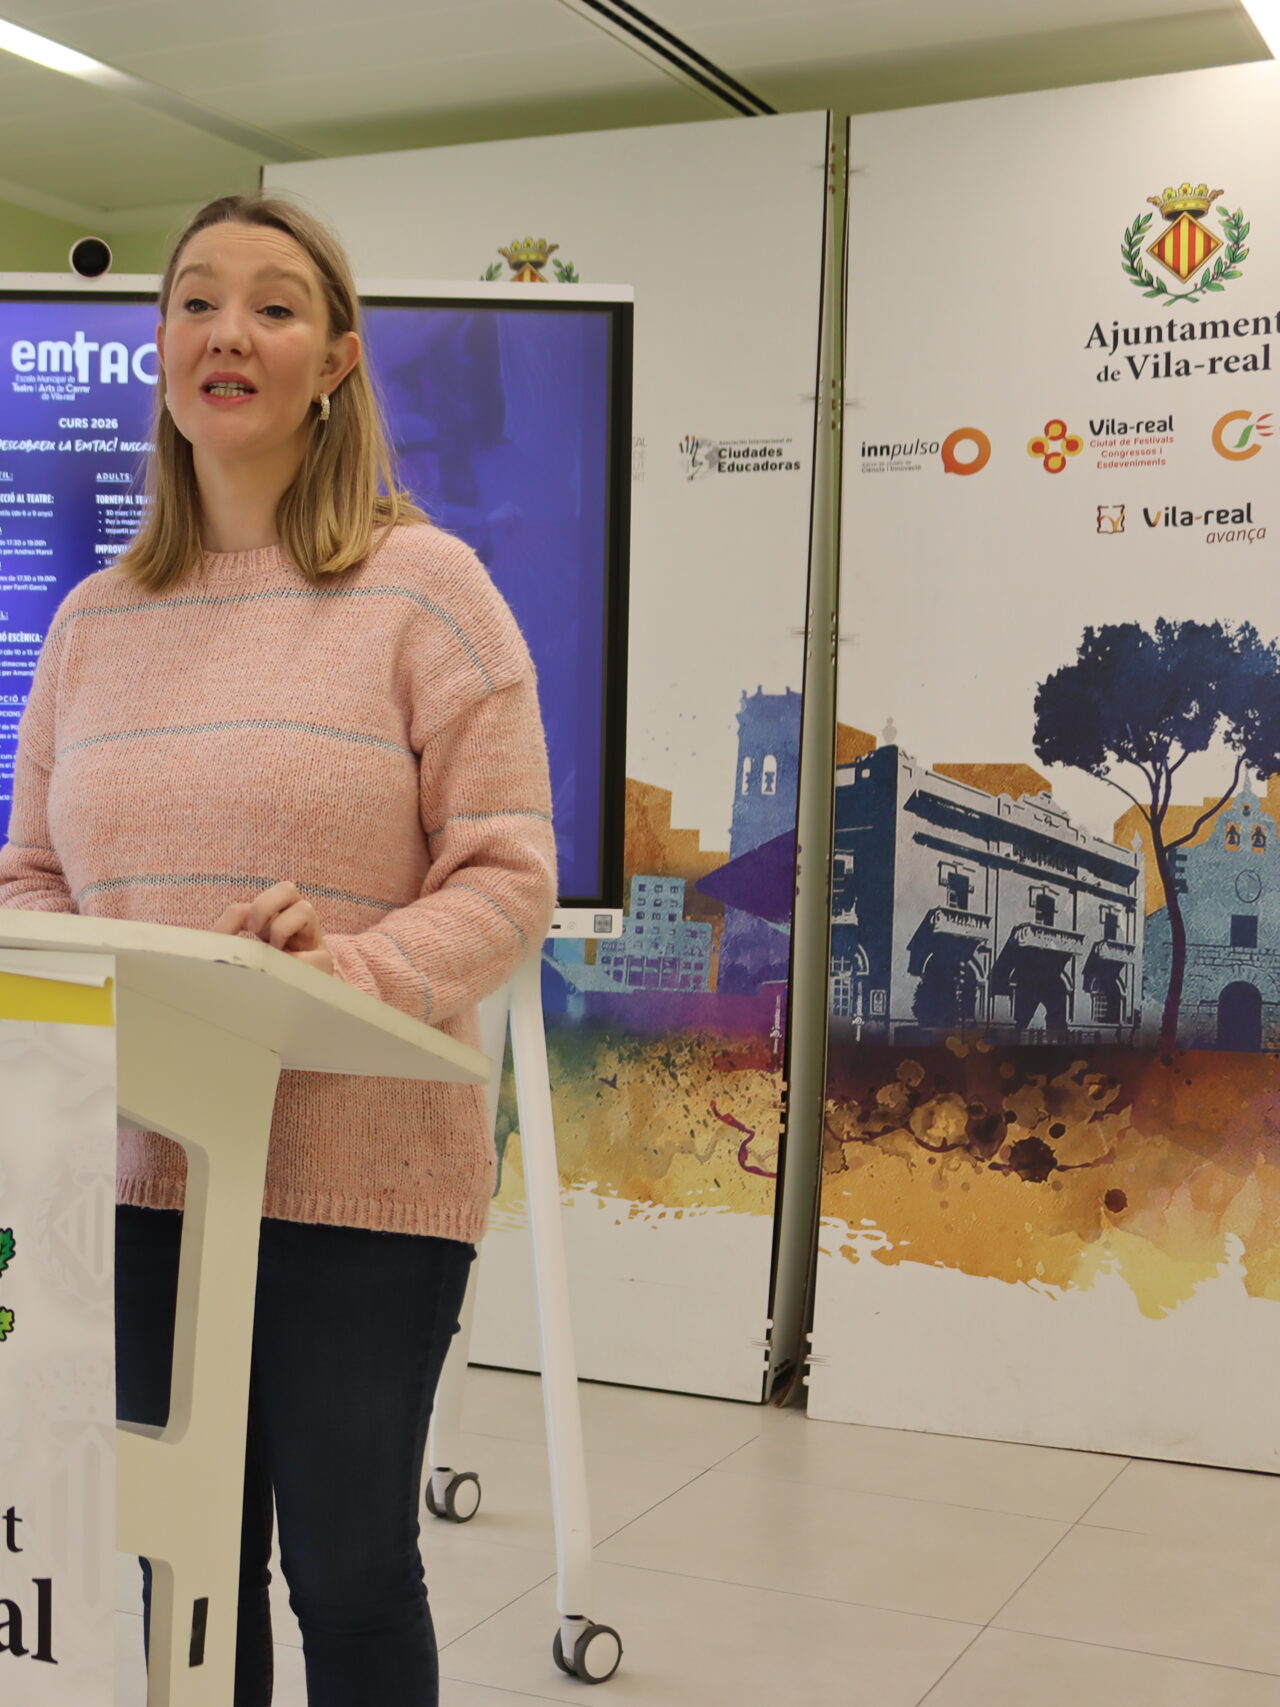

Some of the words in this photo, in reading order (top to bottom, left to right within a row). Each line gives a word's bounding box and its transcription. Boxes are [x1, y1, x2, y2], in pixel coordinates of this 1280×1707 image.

[1084, 310, 1280, 356] Ajuntament
[1096, 365, 1121, 383] de
[1124, 343, 1272, 380] Vila-real
[39, 383, 55, 393] Arts
[59, 417, 88, 429] CURS
[91, 417, 118, 429] 2026
[1089, 415, 1174, 436] Vila-real
[1090, 439, 1117, 448] Ciutat
[1120, 437, 1131, 446] de
[1133, 435, 1174, 445] Festivals
[718, 446, 783, 459] Ciudades
[861, 438, 940, 460] innpulso
[1101, 448, 1156, 459] Congressos
[718, 460, 801, 473] Educadoras
[1097, 458, 1166, 469] Esdeveniments
[16, 493, 25, 503] AL
[26, 493, 55, 504] TEATRE:
[125, 494, 134, 504] AL
[1143, 502, 1253, 528] Vila-real
[1206, 527, 1267, 544] avança
[8, 631, 43, 643] ESCÈNICA:
